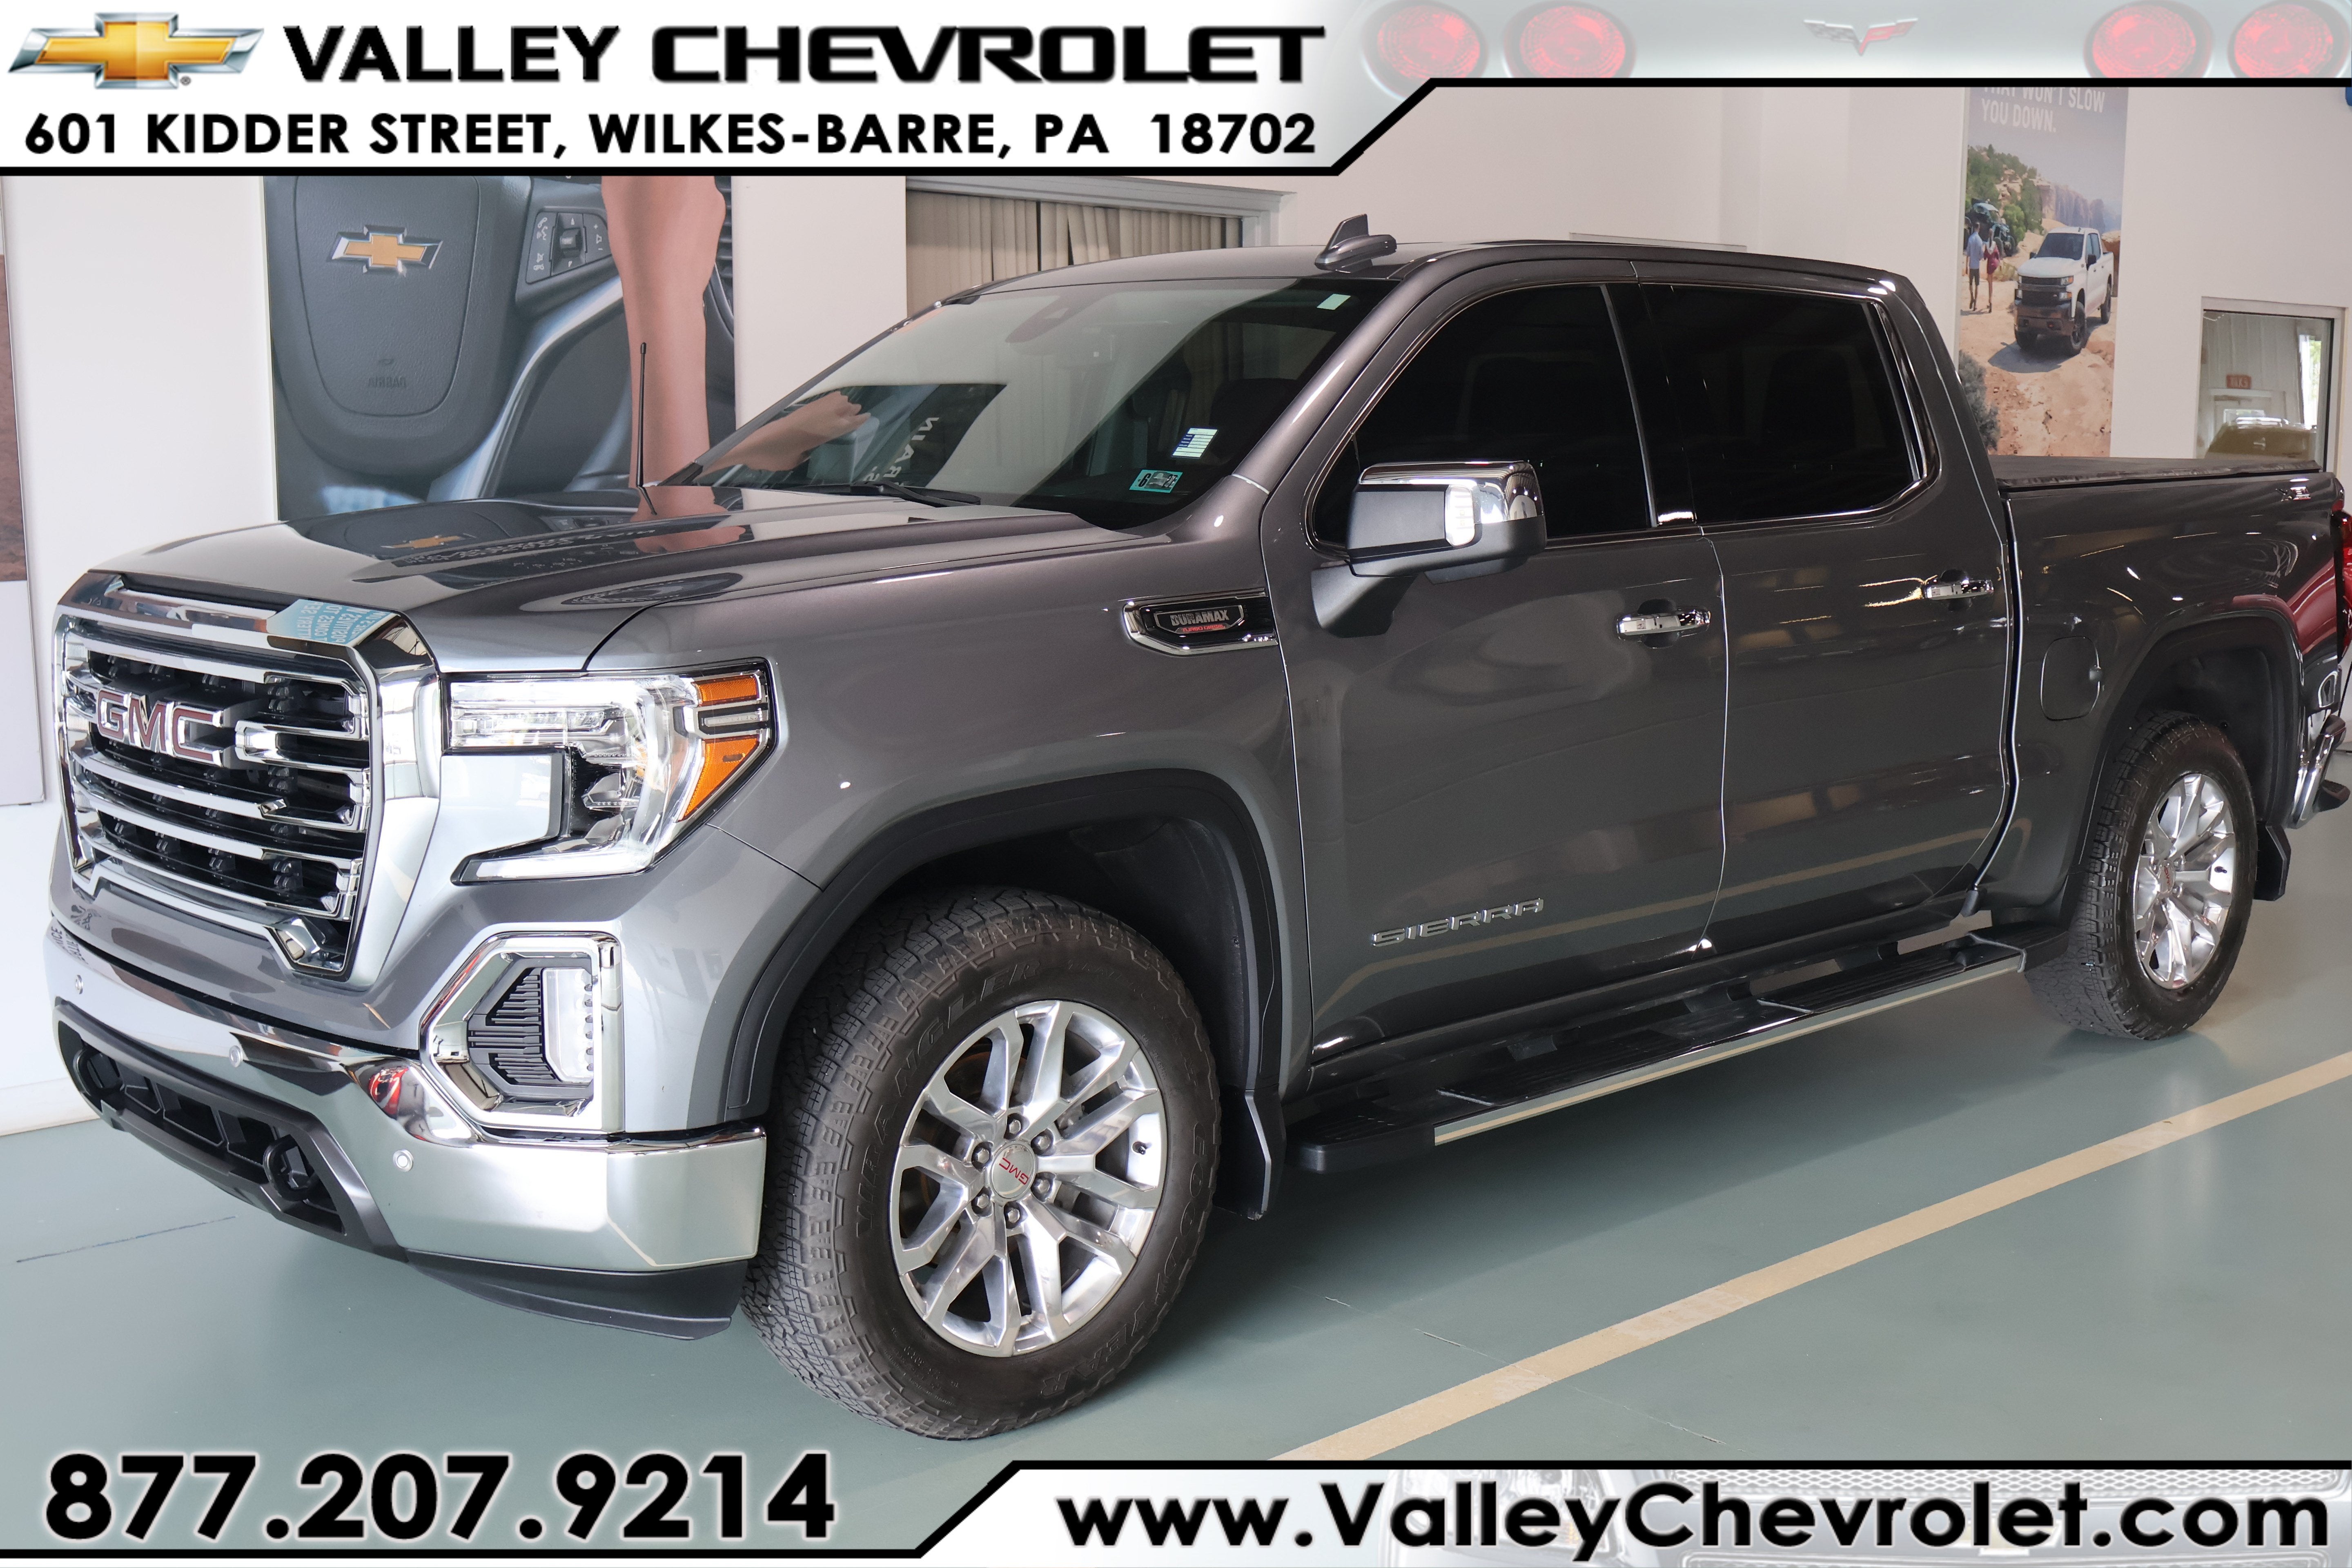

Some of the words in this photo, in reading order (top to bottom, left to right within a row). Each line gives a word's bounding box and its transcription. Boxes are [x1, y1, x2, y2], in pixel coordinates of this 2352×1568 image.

[1981, 98, 2008, 125] YOU
[2012, 104, 2056, 133] DOWN.
[2069, 87, 2105, 113] SLOW
[1138, 473, 1152, 487] 6
[1170, 610, 1229, 626] DURAMAX
[97, 686, 223, 767] GMC
[1372, 898, 1544, 947] SIERRA
[856, 961, 1041, 1238] WRANGLER
[999, 1157, 1029, 1185] GMC
[1040, 1120, 1206, 1396] GOODYEAR
